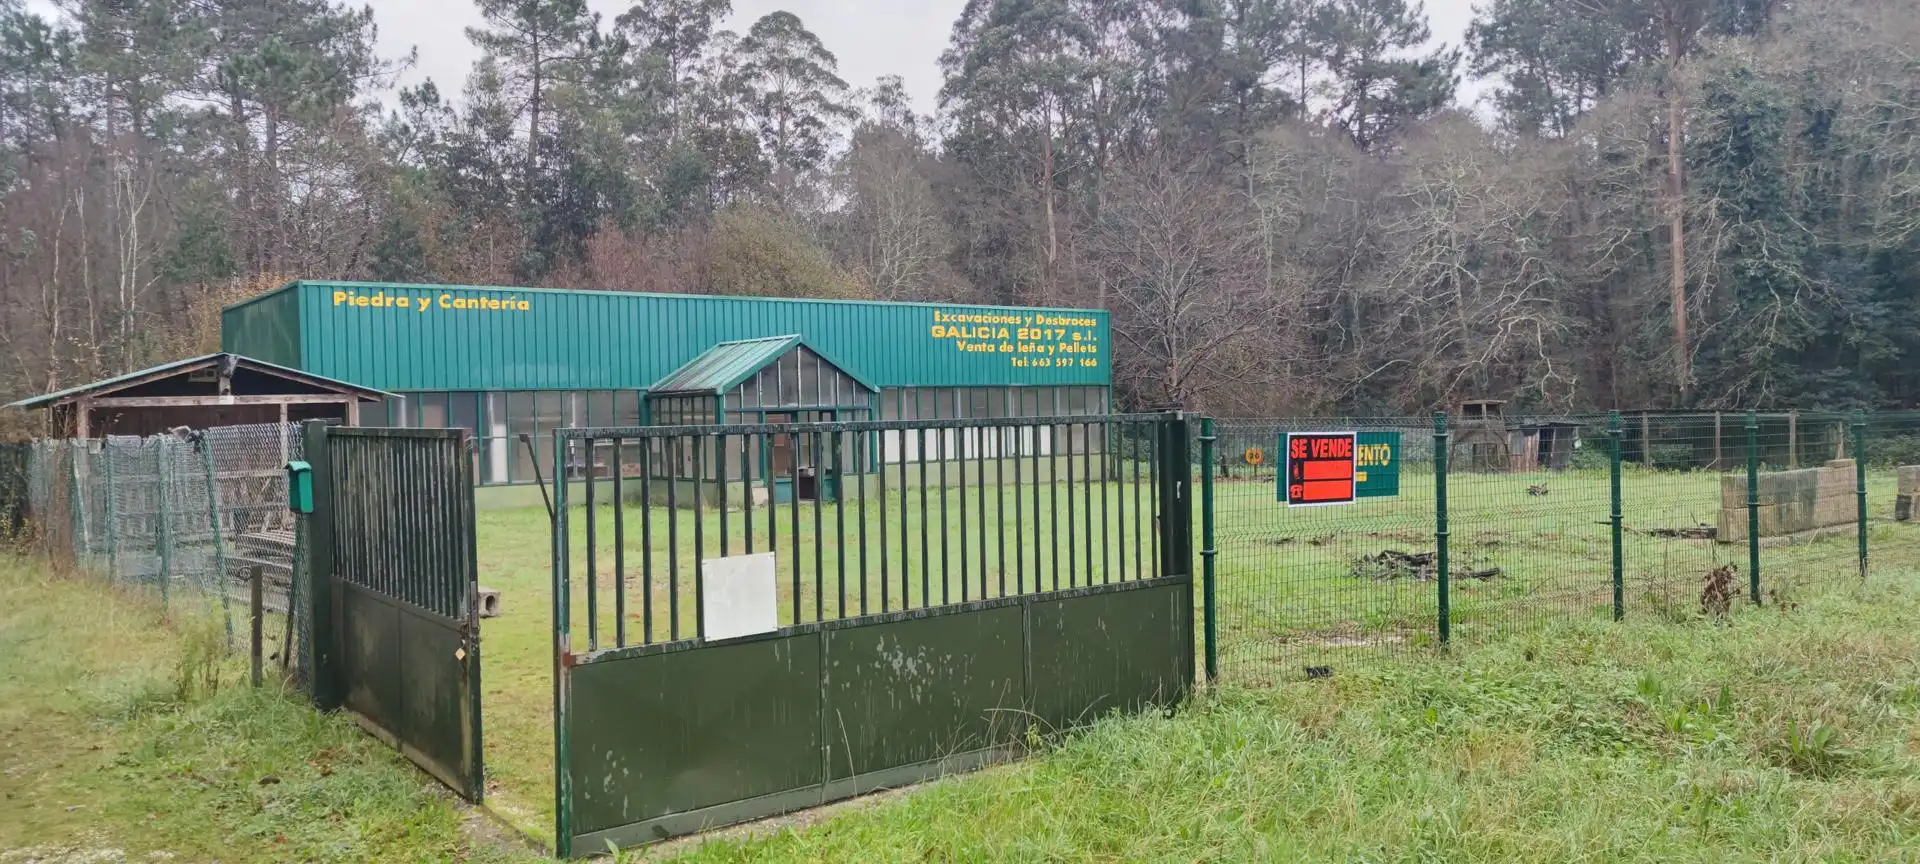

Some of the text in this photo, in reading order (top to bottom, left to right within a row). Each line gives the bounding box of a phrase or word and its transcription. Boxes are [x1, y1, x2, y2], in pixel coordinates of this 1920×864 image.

[333, 291, 530, 312] Piedra y Cantería
[933, 310, 1022, 325] Excavaciones
[1025, 314, 1032, 327] y
[931, 325, 1010, 339] GALICIA
[1017, 328, 1066, 341] 2017
[956, 341, 1097, 356] Venta de leña y Pellets
[1291, 438, 1352, 459] SE VENDE
